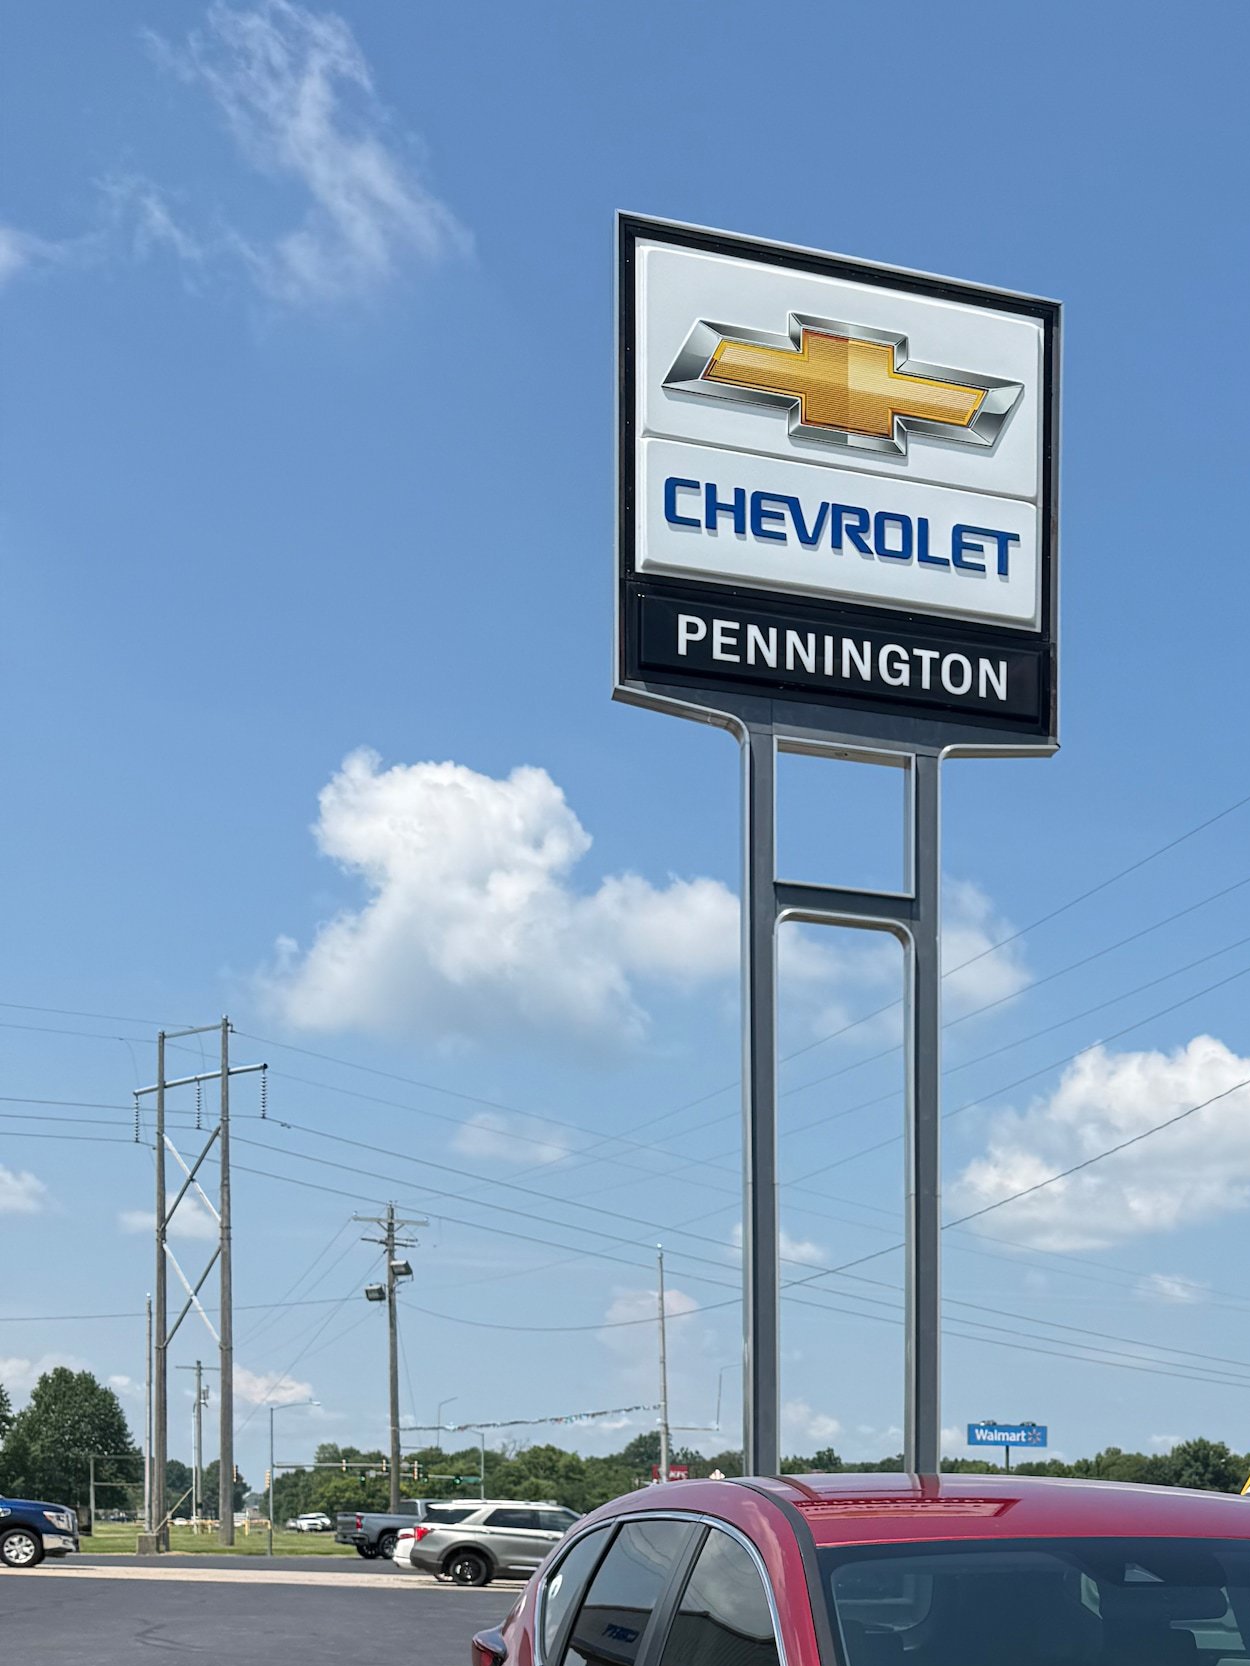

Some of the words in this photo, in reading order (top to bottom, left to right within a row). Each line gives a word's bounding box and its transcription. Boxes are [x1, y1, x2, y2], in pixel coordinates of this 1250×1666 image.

[664, 476, 1020, 576] CHEVROLET
[677, 613, 1009, 701] PENNINGTON
[975, 1428, 1027, 1442] Walmart
